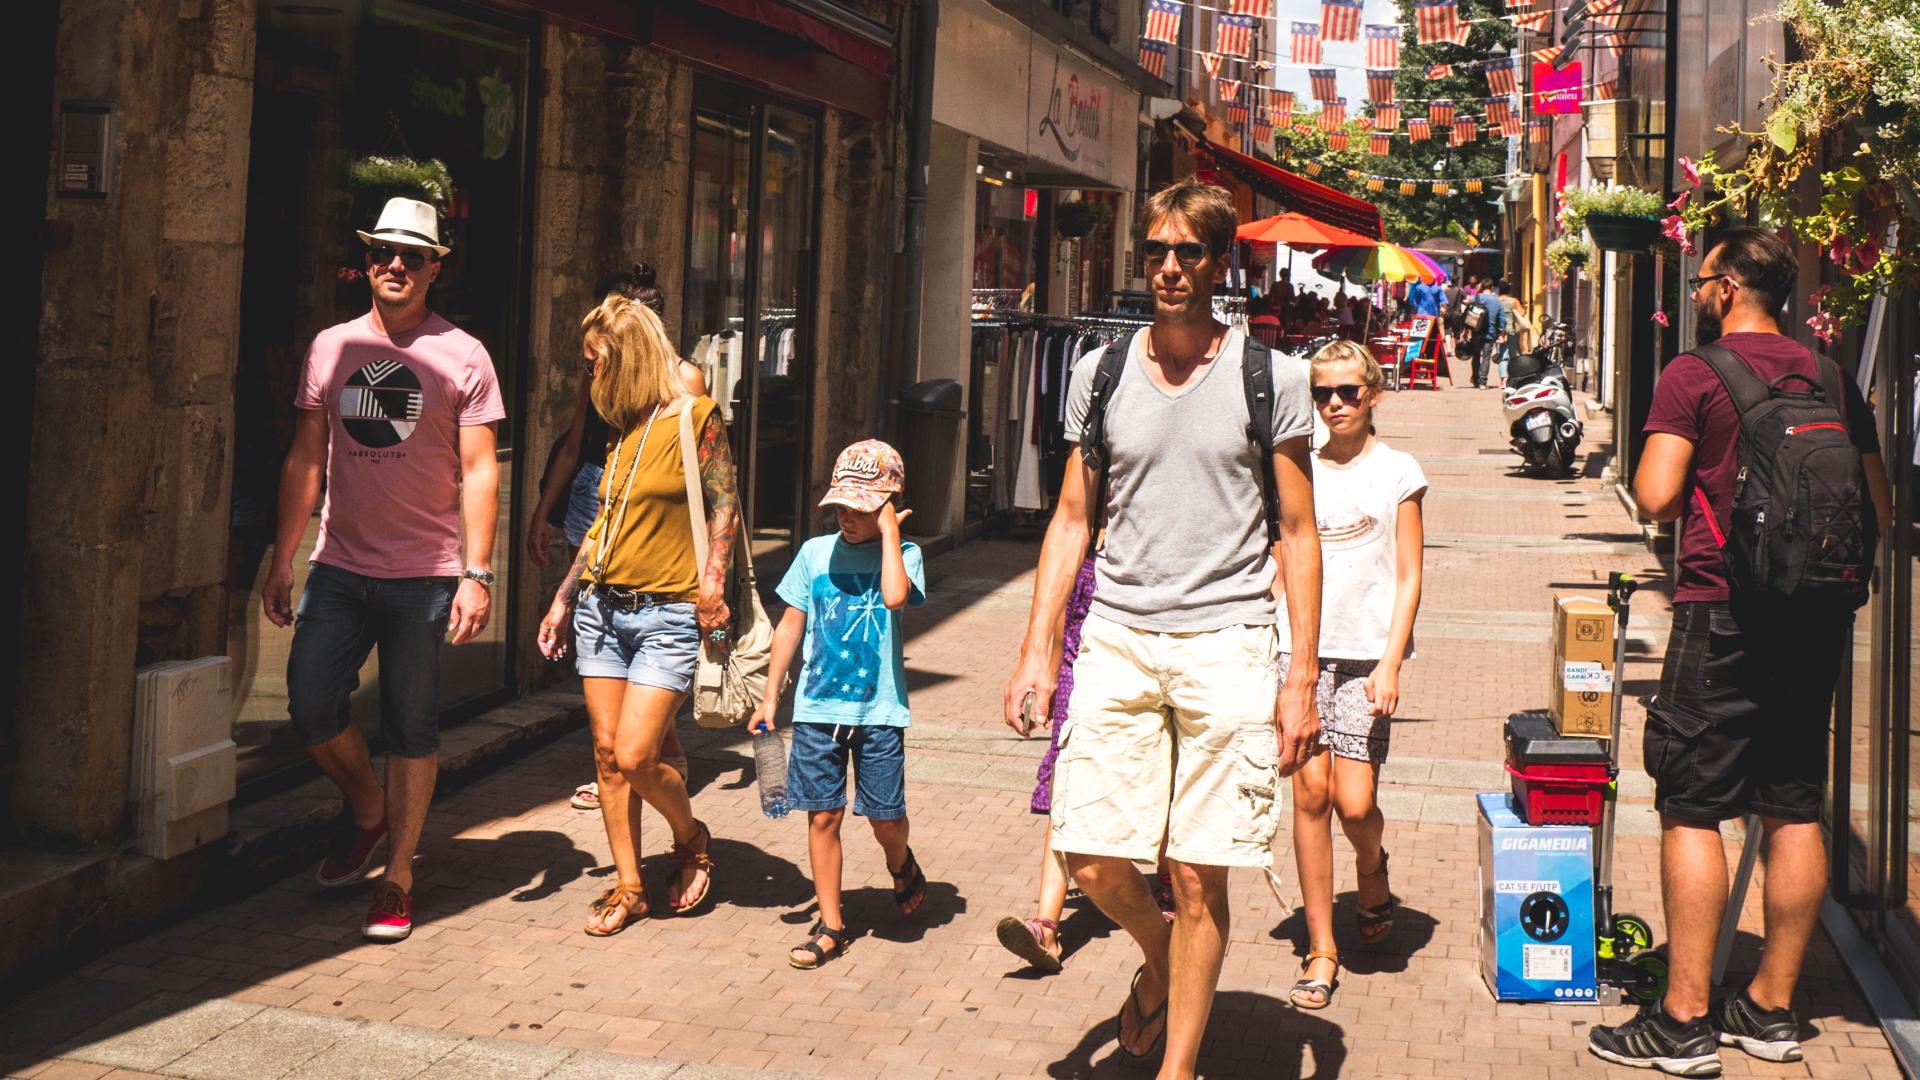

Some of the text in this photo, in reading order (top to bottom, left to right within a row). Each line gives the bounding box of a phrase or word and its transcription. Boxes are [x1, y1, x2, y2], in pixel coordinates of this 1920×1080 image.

[1039, 53, 1081, 161] La
[837, 452, 881, 476] Dubai
[1502, 837, 1587, 850] GIGAMEDIA
[1531, 882, 1558, 892] F/UTP
